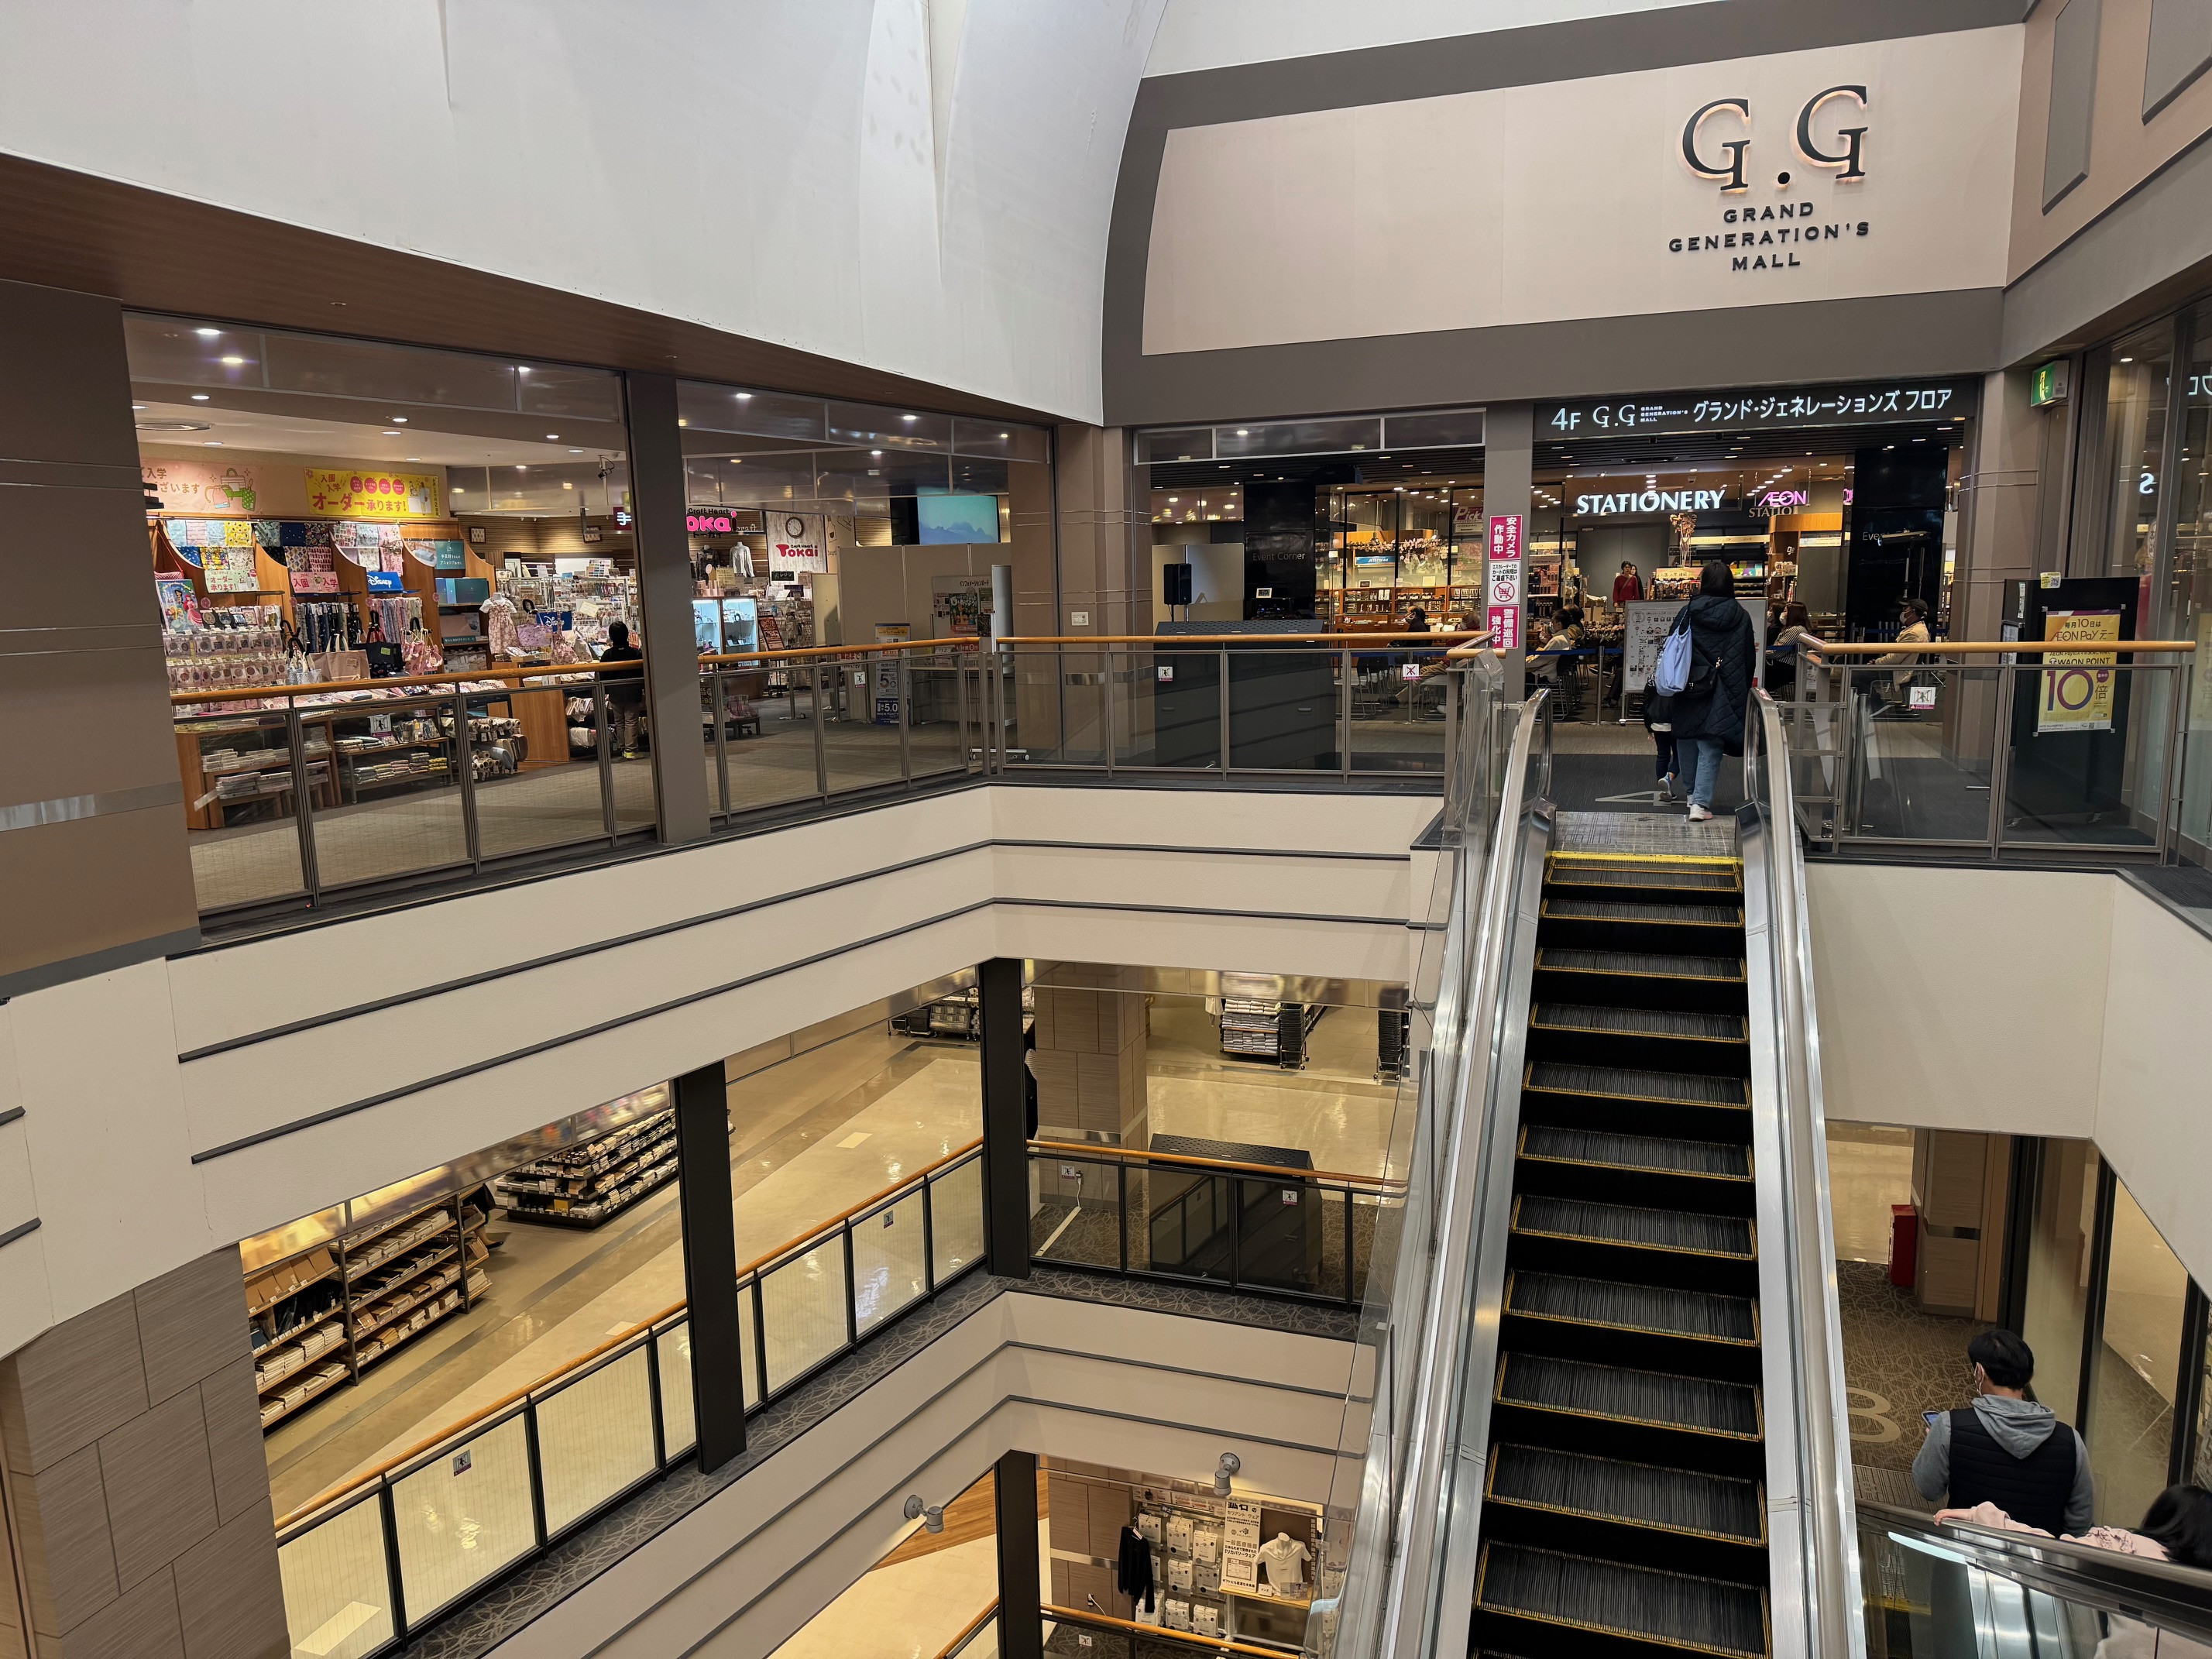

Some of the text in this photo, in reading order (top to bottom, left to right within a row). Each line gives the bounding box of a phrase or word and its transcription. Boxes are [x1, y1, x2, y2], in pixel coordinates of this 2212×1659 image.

[1682, 85, 1868, 191] G.G
[1723, 202, 1814, 222] GRAND
[1669, 222, 1869, 252] GENERATION'S
[1732, 252, 1801, 271] MALL
[1551, 407, 1581, 430] 4F
[1905, 389, 1952, 411] フロア
[142, 468, 167, 479] 入学
[321, 474, 335, 483] 入園
[155, 482, 200, 494] ざいます
[1577, 489, 1726, 514] STATIONERY
[686, 510, 737, 532] okai
[1493, 524, 1504, 555] 作動中
[1506, 517, 1517, 558] 安全カメラ
[1252, 551, 1306, 561] Event Corner
[294, 578, 338, 587] 入園 入学
[1491, 615, 1502, 644] 強化中
[1503, 608, 1514, 647] 警備巡回
[2065, 618, 2101, 628] 毎月10日は
[2047, 670, 2094, 710] 10
[2094, 685, 2108, 699] 倍
